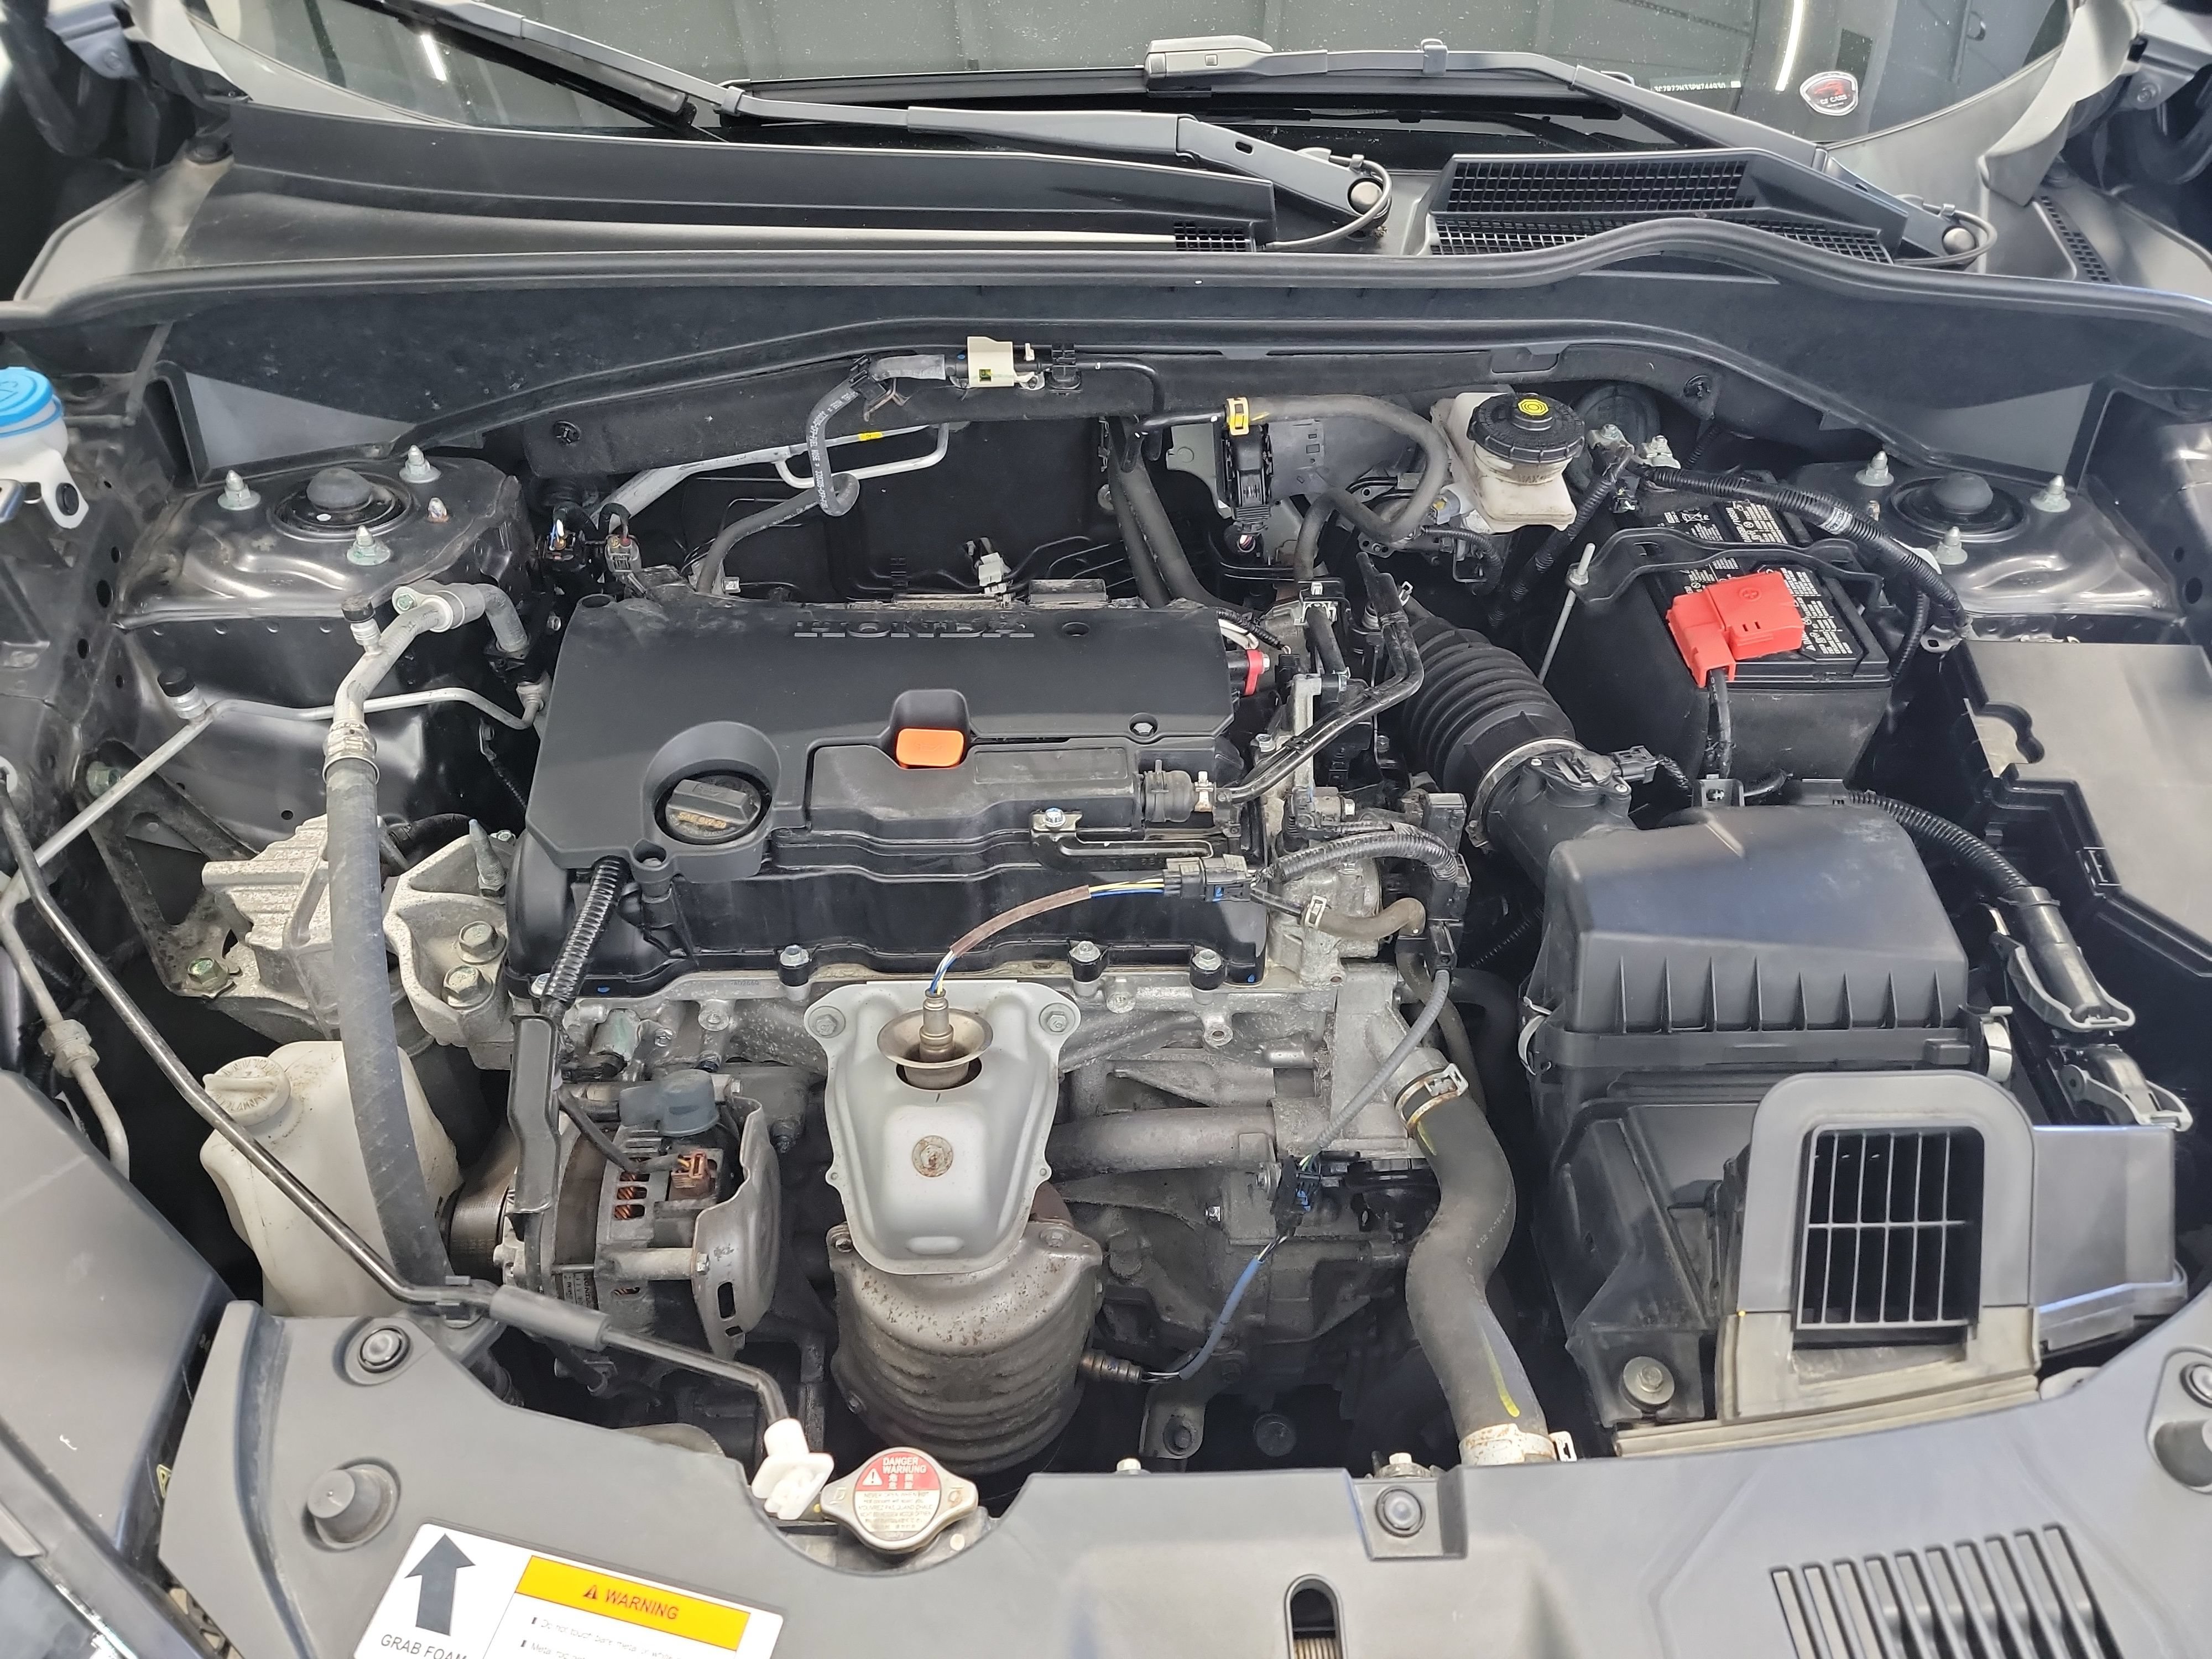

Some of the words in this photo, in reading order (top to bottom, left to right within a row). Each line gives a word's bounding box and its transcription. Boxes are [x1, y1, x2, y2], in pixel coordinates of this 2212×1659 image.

[794, 620, 1034, 638] HONDA
[677, 811, 698, 824] SAE
[883, 1457, 919, 1465] DANGER
[883, 1465, 927, 1474] WARNUNG
[605, 1588, 680, 1620] WARNING
[380, 1633, 422, 1655] GRAB
